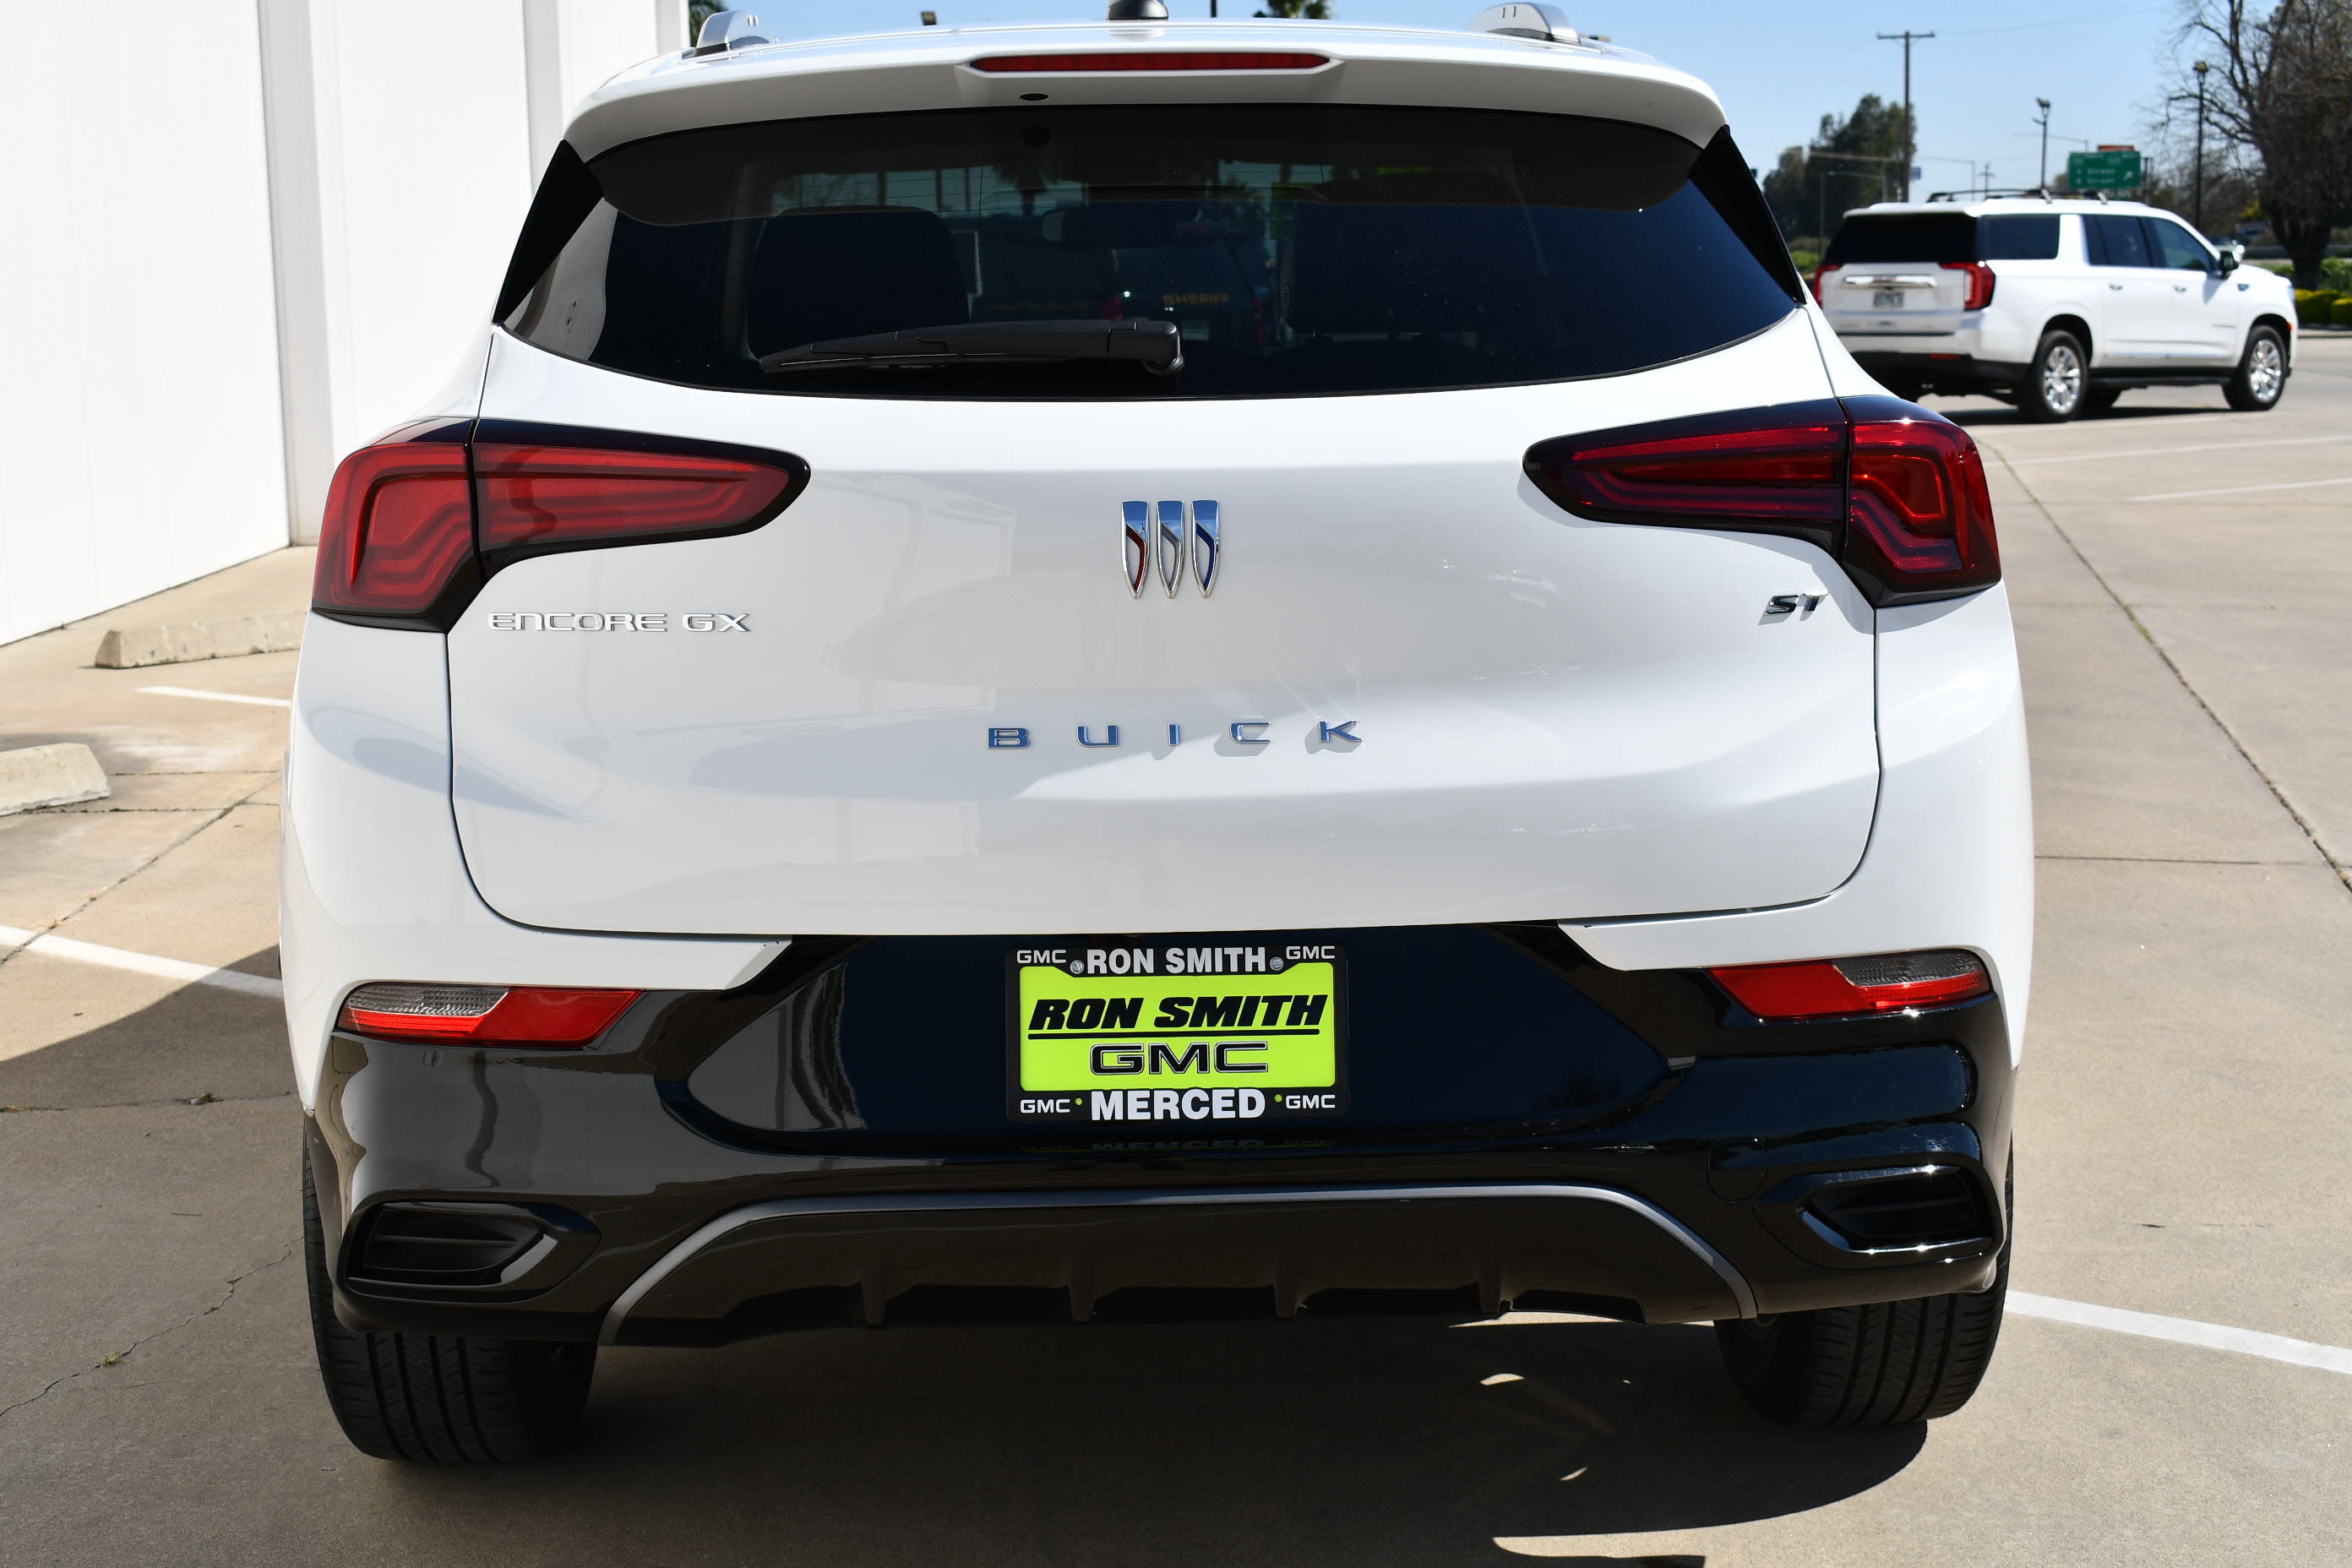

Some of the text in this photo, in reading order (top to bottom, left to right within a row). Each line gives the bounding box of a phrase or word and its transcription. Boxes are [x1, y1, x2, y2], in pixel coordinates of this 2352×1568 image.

[1764, 593, 1828, 615] ST
[487, 612, 751, 633] ENCORE GX
[987, 719, 1364, 749] BUICK
[1017, 949, 1068, 964] GMC
[1086, 947, 1266, 974] RON SMITH
[1285, 945, 1336, 960] GMC
[1028, 994, 1328, 1031] RON SMITH
[1090, 1041, 1269, 1075] GMC
[1021, 1098, 1071, 1114] GMC
[1091, 1089, 1266, 1120] MERCED
[1285, 1094, 1337, 1109] GMC
